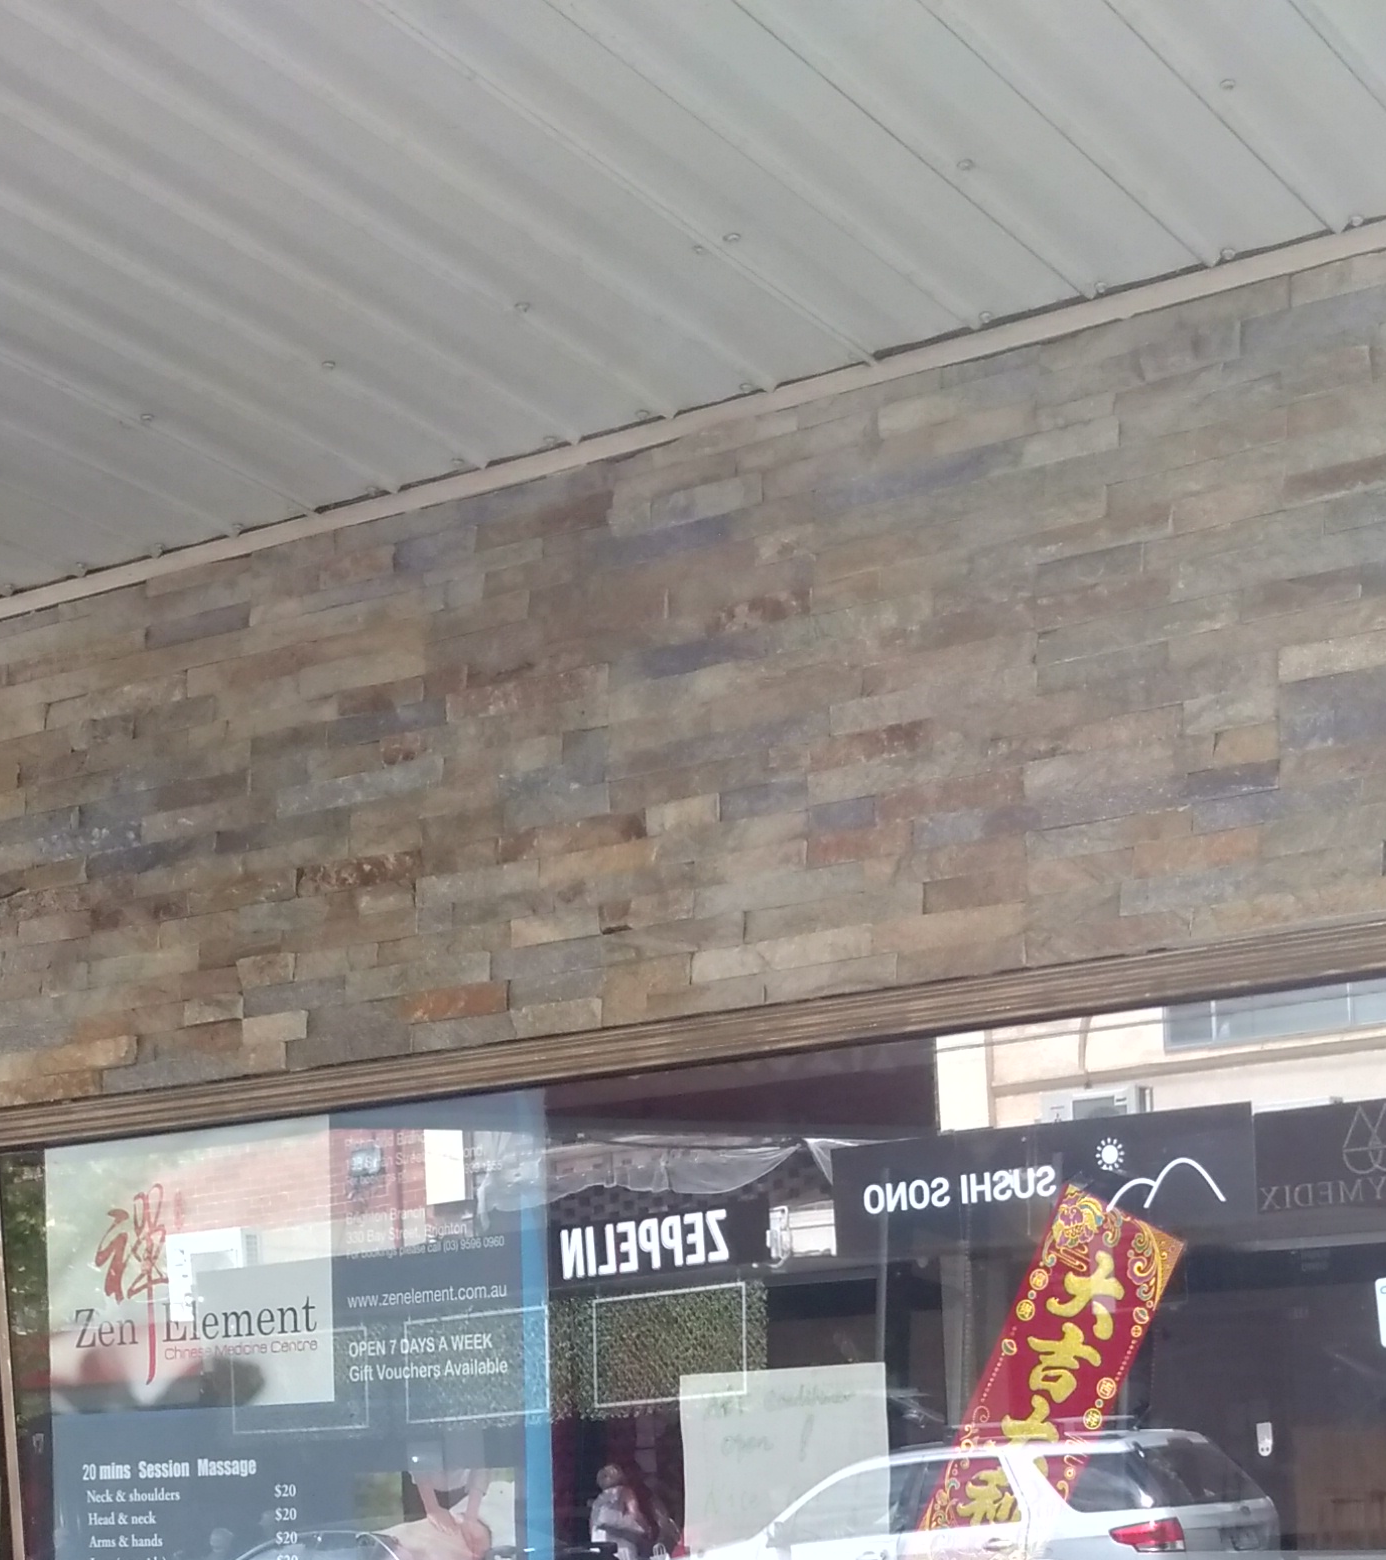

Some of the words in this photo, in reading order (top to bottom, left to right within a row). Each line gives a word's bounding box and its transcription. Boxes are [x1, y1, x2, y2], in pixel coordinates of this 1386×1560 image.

[400, 1243, 426, 1256] please
[428, 1241, 441, 1252] call
[444, 1240, 459, 1253] (03)
[347, 1285, 507, 1308] www.zenelement.com.au
[75, 1308, 138, 1349] Zen
[163, 1296, 317, 1342] Element
[215, 1341, 267, 1357] Medicine
[349, 1341, 385, 1357] OPEN
[390, 1340, 396, 1354] 7
[401, 1337, 435, 1354] DAYS
[439, 1339, 448, 1351] A
[451, 1334, 492, 1350] WEEK
[349, 1365, 373, 1382] Gift
[376, 1364, 440, 1380] Vouchers
[445, 1358, 507, 1376] Available
[82, 1464, 96, 1480] 20
[99, 1462, 131, 1480] mins
[138, 1461, 190, 1479] Session
[198, 1459, 257, 1478] Massage
[87, 1490, 113, 1502] Neck
[129, 1488, 180, 1502] shoulders
[274, 1484, 296, 1497] $20
[88, 1513, 116, 1525] Head
[132, 1511, 156, 1524] neck
[275, 1508, 297, 1521] $20
[89, 1536, 116, 1548] Arms
[132, 1534, 163, 1547] hands
[276, 1532, 298, 1545] $20
